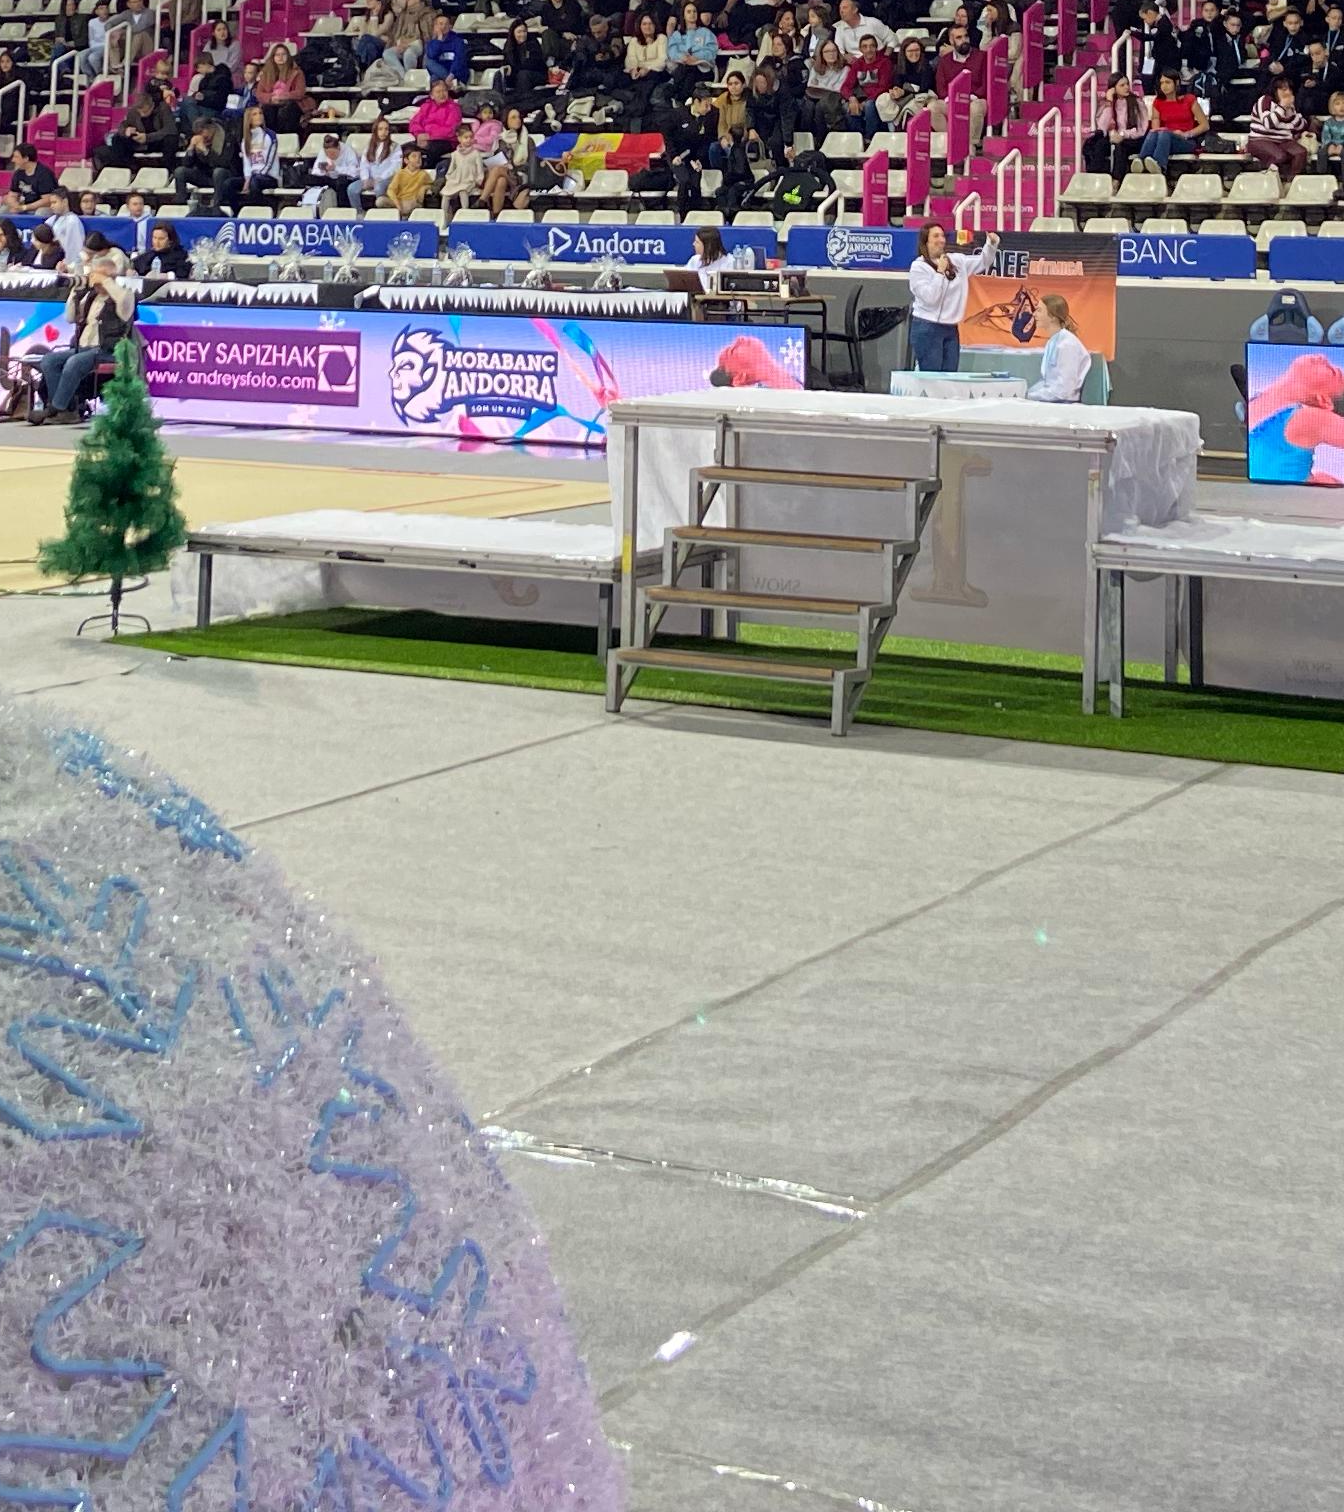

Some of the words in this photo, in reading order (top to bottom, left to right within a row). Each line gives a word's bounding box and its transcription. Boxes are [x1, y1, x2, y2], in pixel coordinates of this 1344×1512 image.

[238, 222, 363, 247] MORABANC
[574, 231, 666, 256] Andorra
[973, 247, 1029, 279] AEE
[1119, 237, 1197, 266] BANC
[146, 339, 211, 363] NDREY
[215, 341, 317, 369] SAPIZHAK
[444, 350, 556, 373] MORABANC
[444, 370, 555, 406] ANDORRA
[471, 404, 490, 413] SOM
[491, 405, 504, 413] UN
